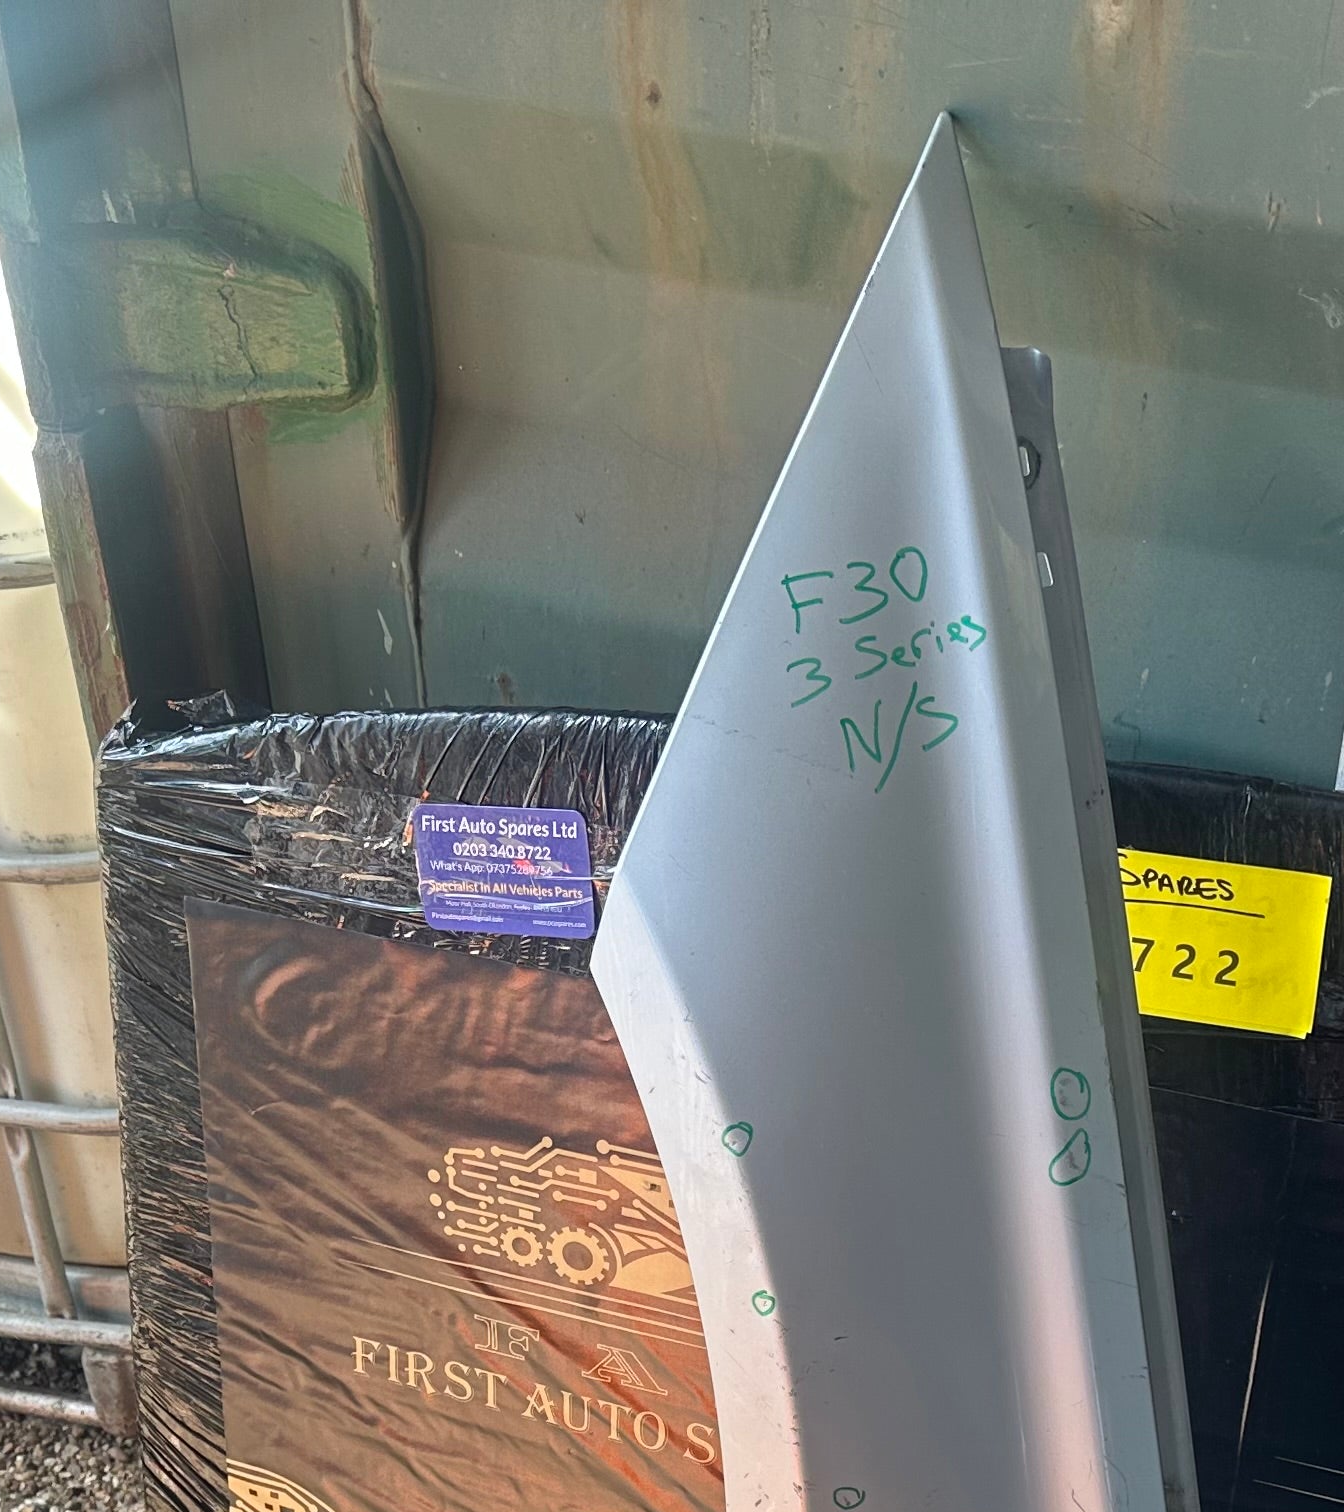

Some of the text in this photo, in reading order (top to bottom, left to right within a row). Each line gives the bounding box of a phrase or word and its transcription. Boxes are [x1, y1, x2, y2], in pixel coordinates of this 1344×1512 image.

[780, 545, 928, 635] F30
[786, 615, 988, 709] 3 Series
[839, 680, 959, 794] N/S
[421, 815, 578, 839] First Auto Spares Ltd
[452, 842, 552, 861] 0203 340 8722
[427, 880, 480, 895] Specialist
[493, 883, 507, 893] All
[509, 884, 553, 898] Vehicles
[555, 886, 583, 899] Parts
[430, 860, 463, 872] What's
[1118, 853, 1234, 901] SPARES
[1132, 937, 1240, 987] 722
[474, 1314, 669, 1396] FA
[351, 1335, 508, 1412] FIRST
[522, 1383, 669, 1453] AUTO
